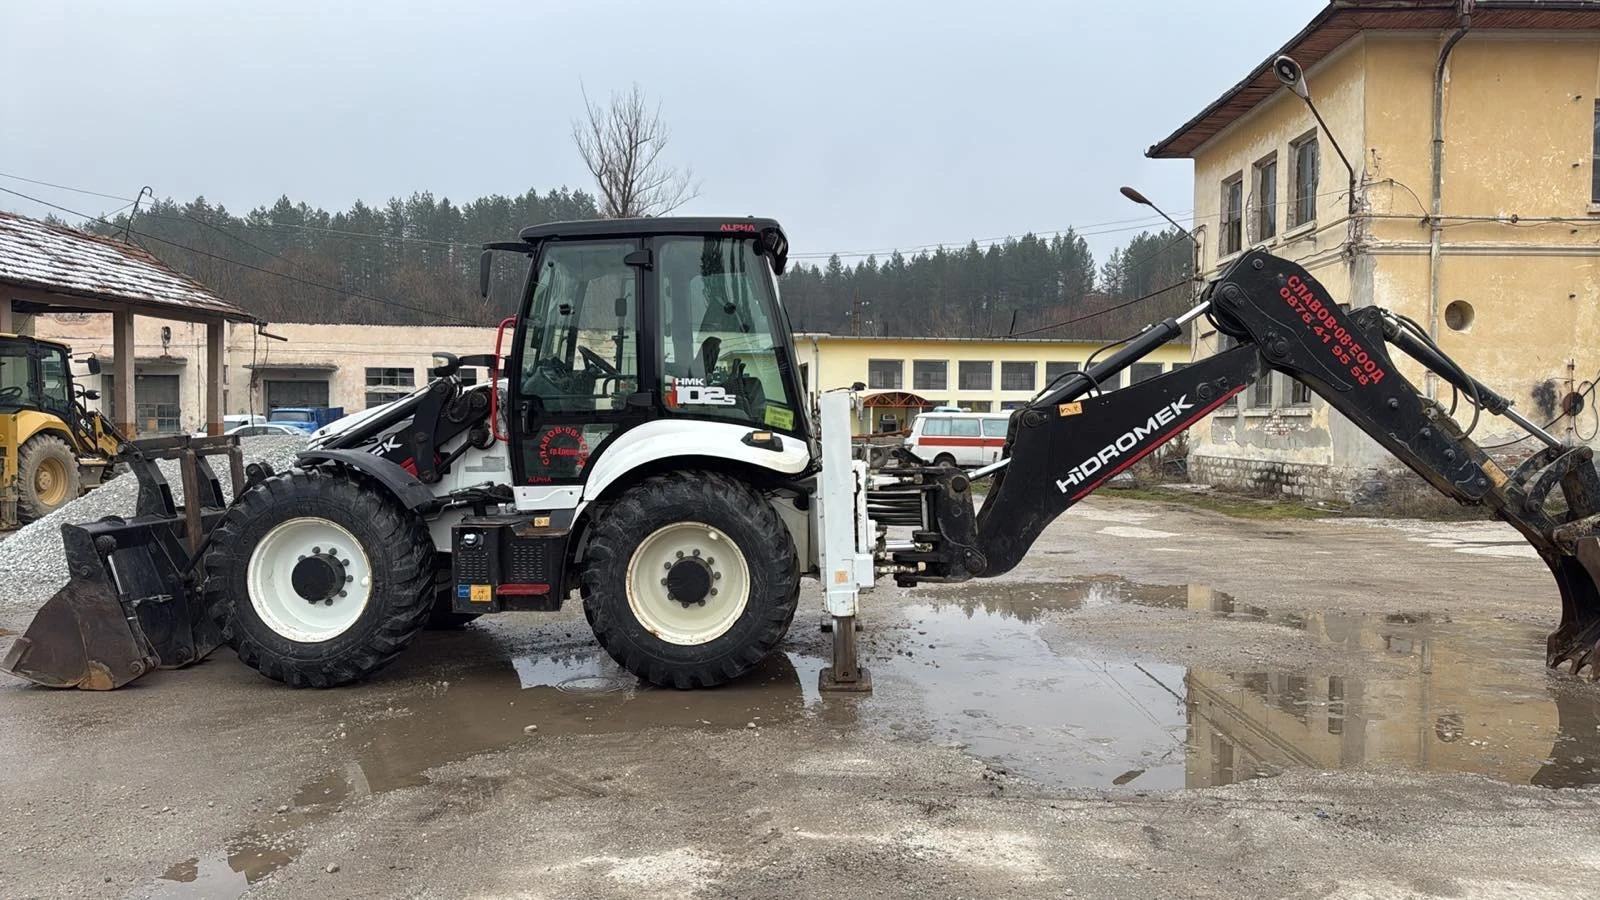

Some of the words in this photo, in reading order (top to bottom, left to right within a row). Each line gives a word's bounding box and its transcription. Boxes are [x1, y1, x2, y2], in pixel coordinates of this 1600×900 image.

[720, 224, 755, 232] ALPHA
[1279, 287, 1313, 324] 0878
[1313, 325, 1331, 344] 41
[1331, 344, 1351, 365] 95
[1351, 366, 1369, 386] 58
[675, 377, 705, 386] HMK
